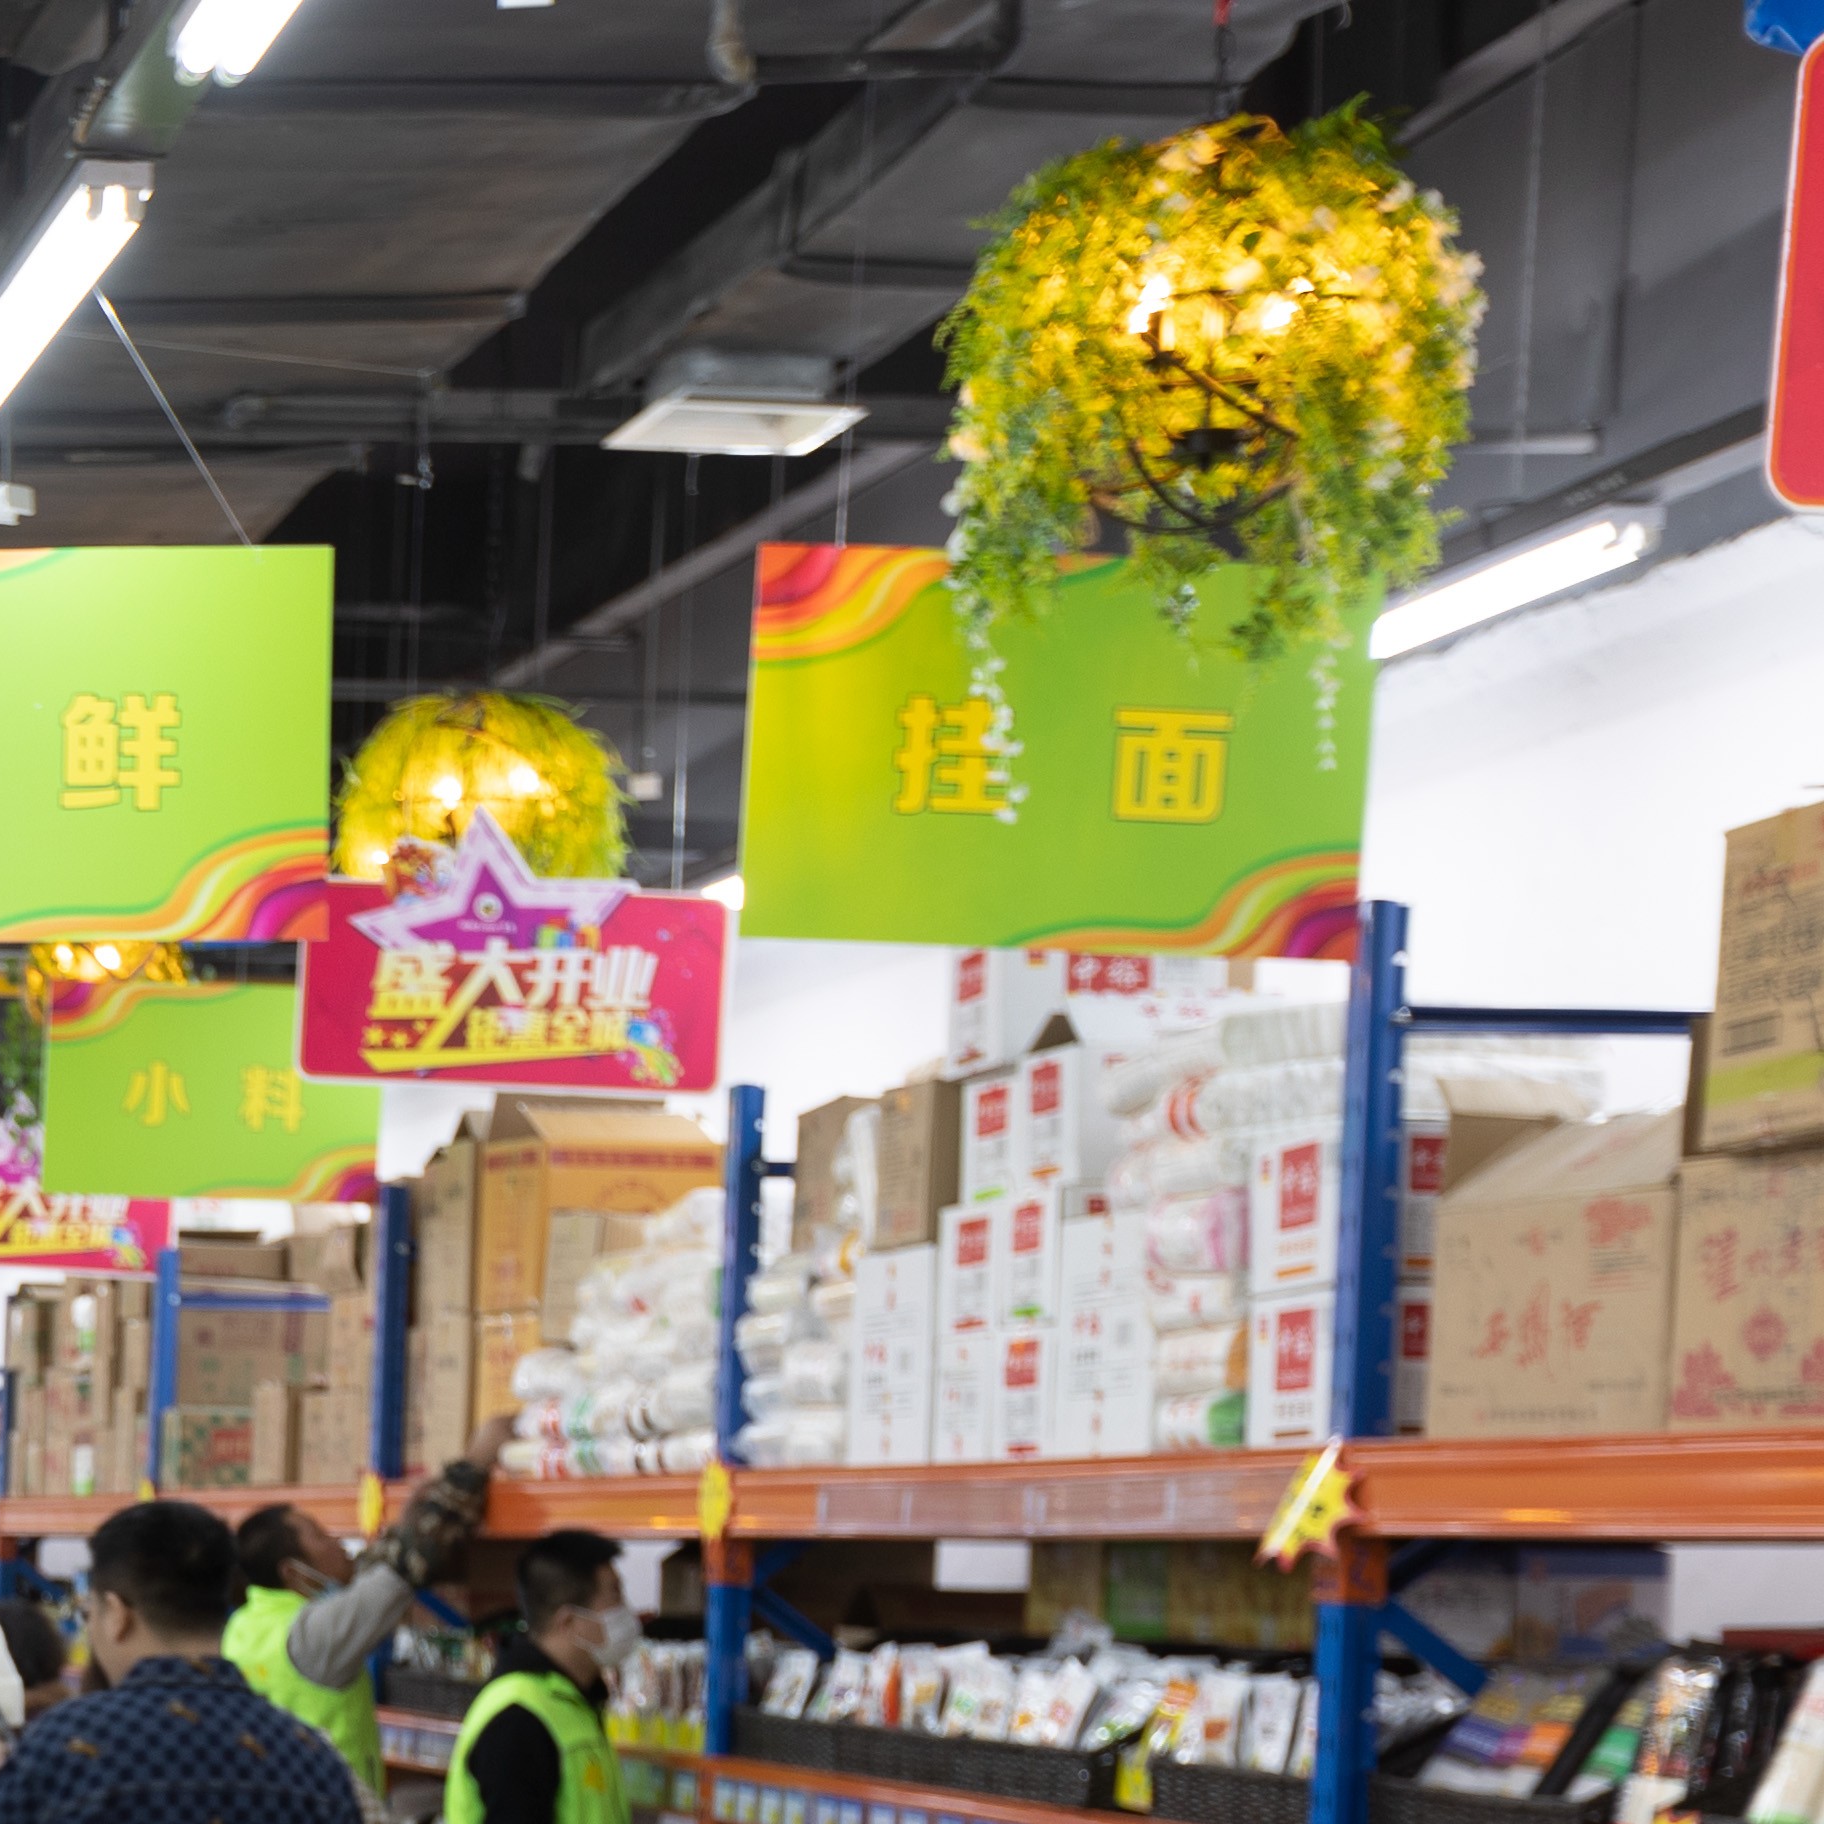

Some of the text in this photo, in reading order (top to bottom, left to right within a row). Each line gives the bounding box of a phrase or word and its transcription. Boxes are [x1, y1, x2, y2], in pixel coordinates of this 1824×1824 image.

[893, 693, 1234, 824] 挂面
[366, 937, 660, 1032] 盛大开业
[121, 1060, 306, 1134] 小料
